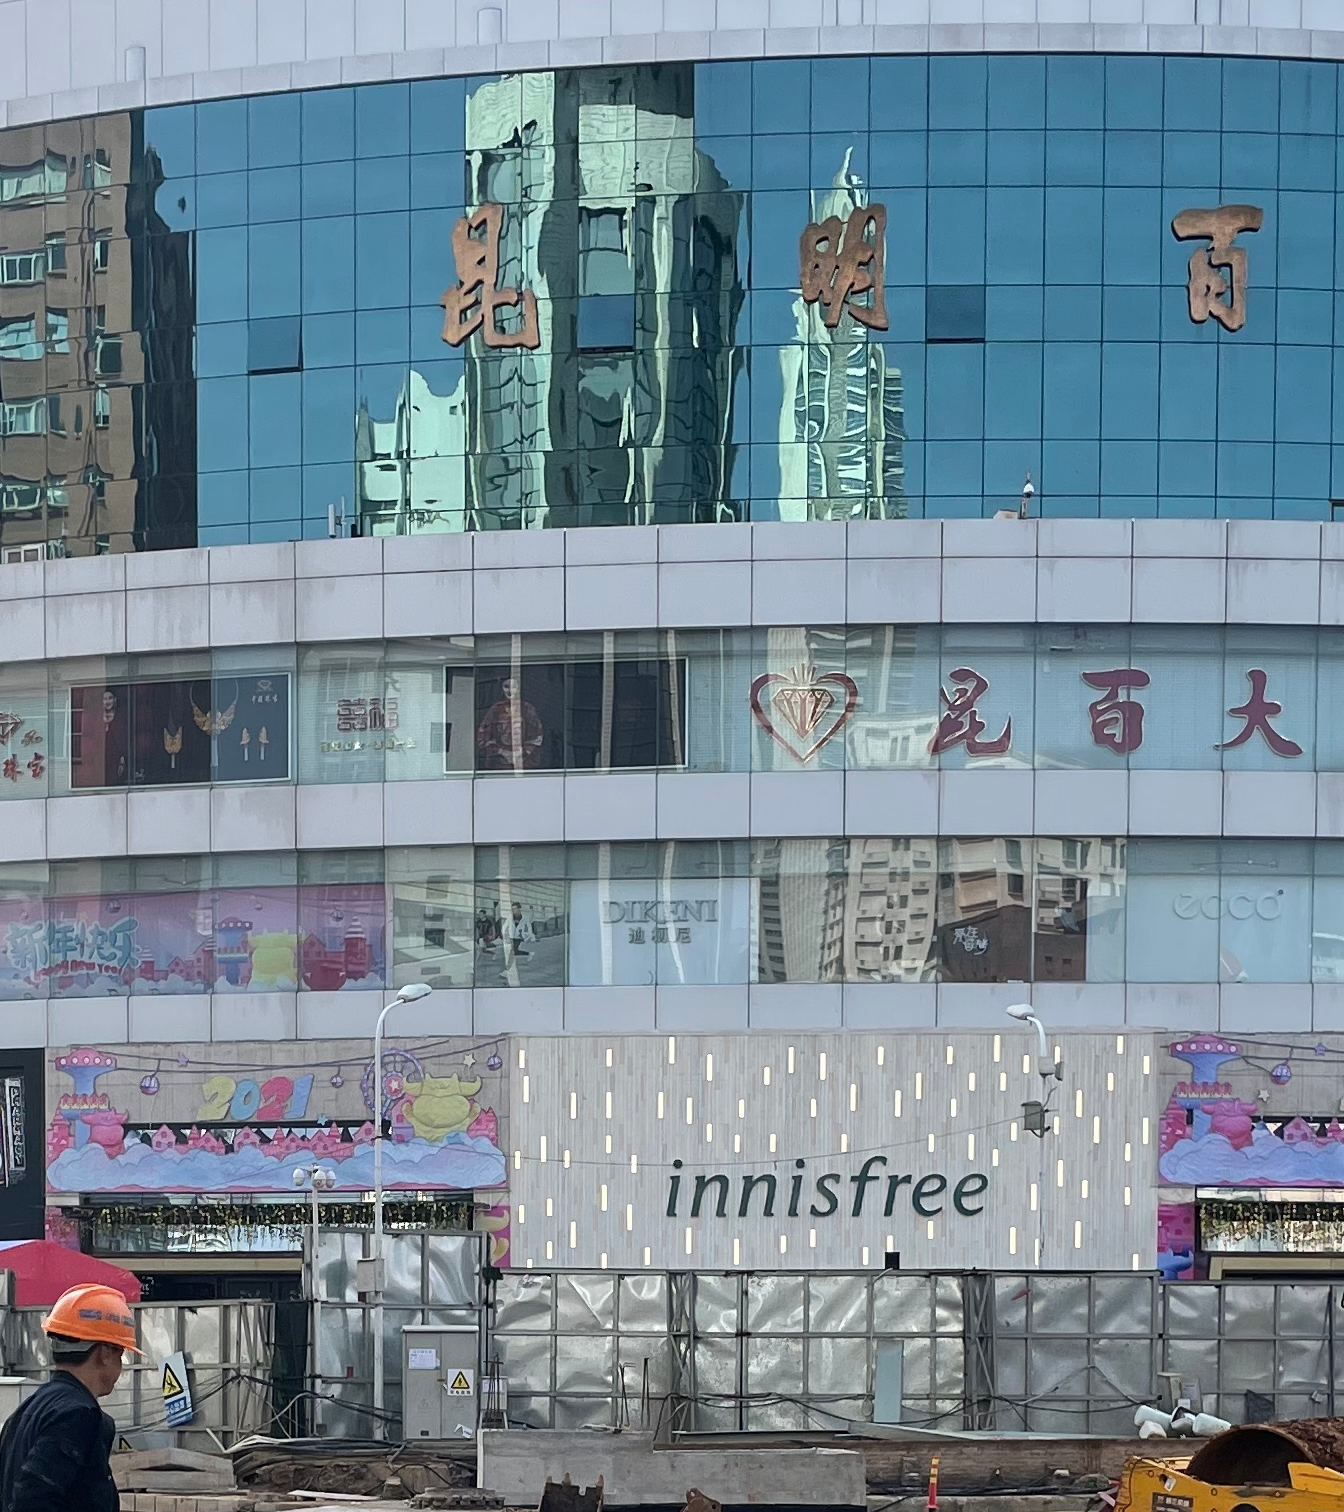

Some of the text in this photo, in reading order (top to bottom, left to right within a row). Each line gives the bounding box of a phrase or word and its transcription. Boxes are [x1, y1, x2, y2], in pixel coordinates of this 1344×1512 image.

[602, 899, 718, 925] DIKENI
[1173, 893, 1282, 921] ecco
[4, 917, 141, 970] 新年快乐
[198, 1074, 314, 1122] 2021
[666, 1155, 989, 1218] innisfree
